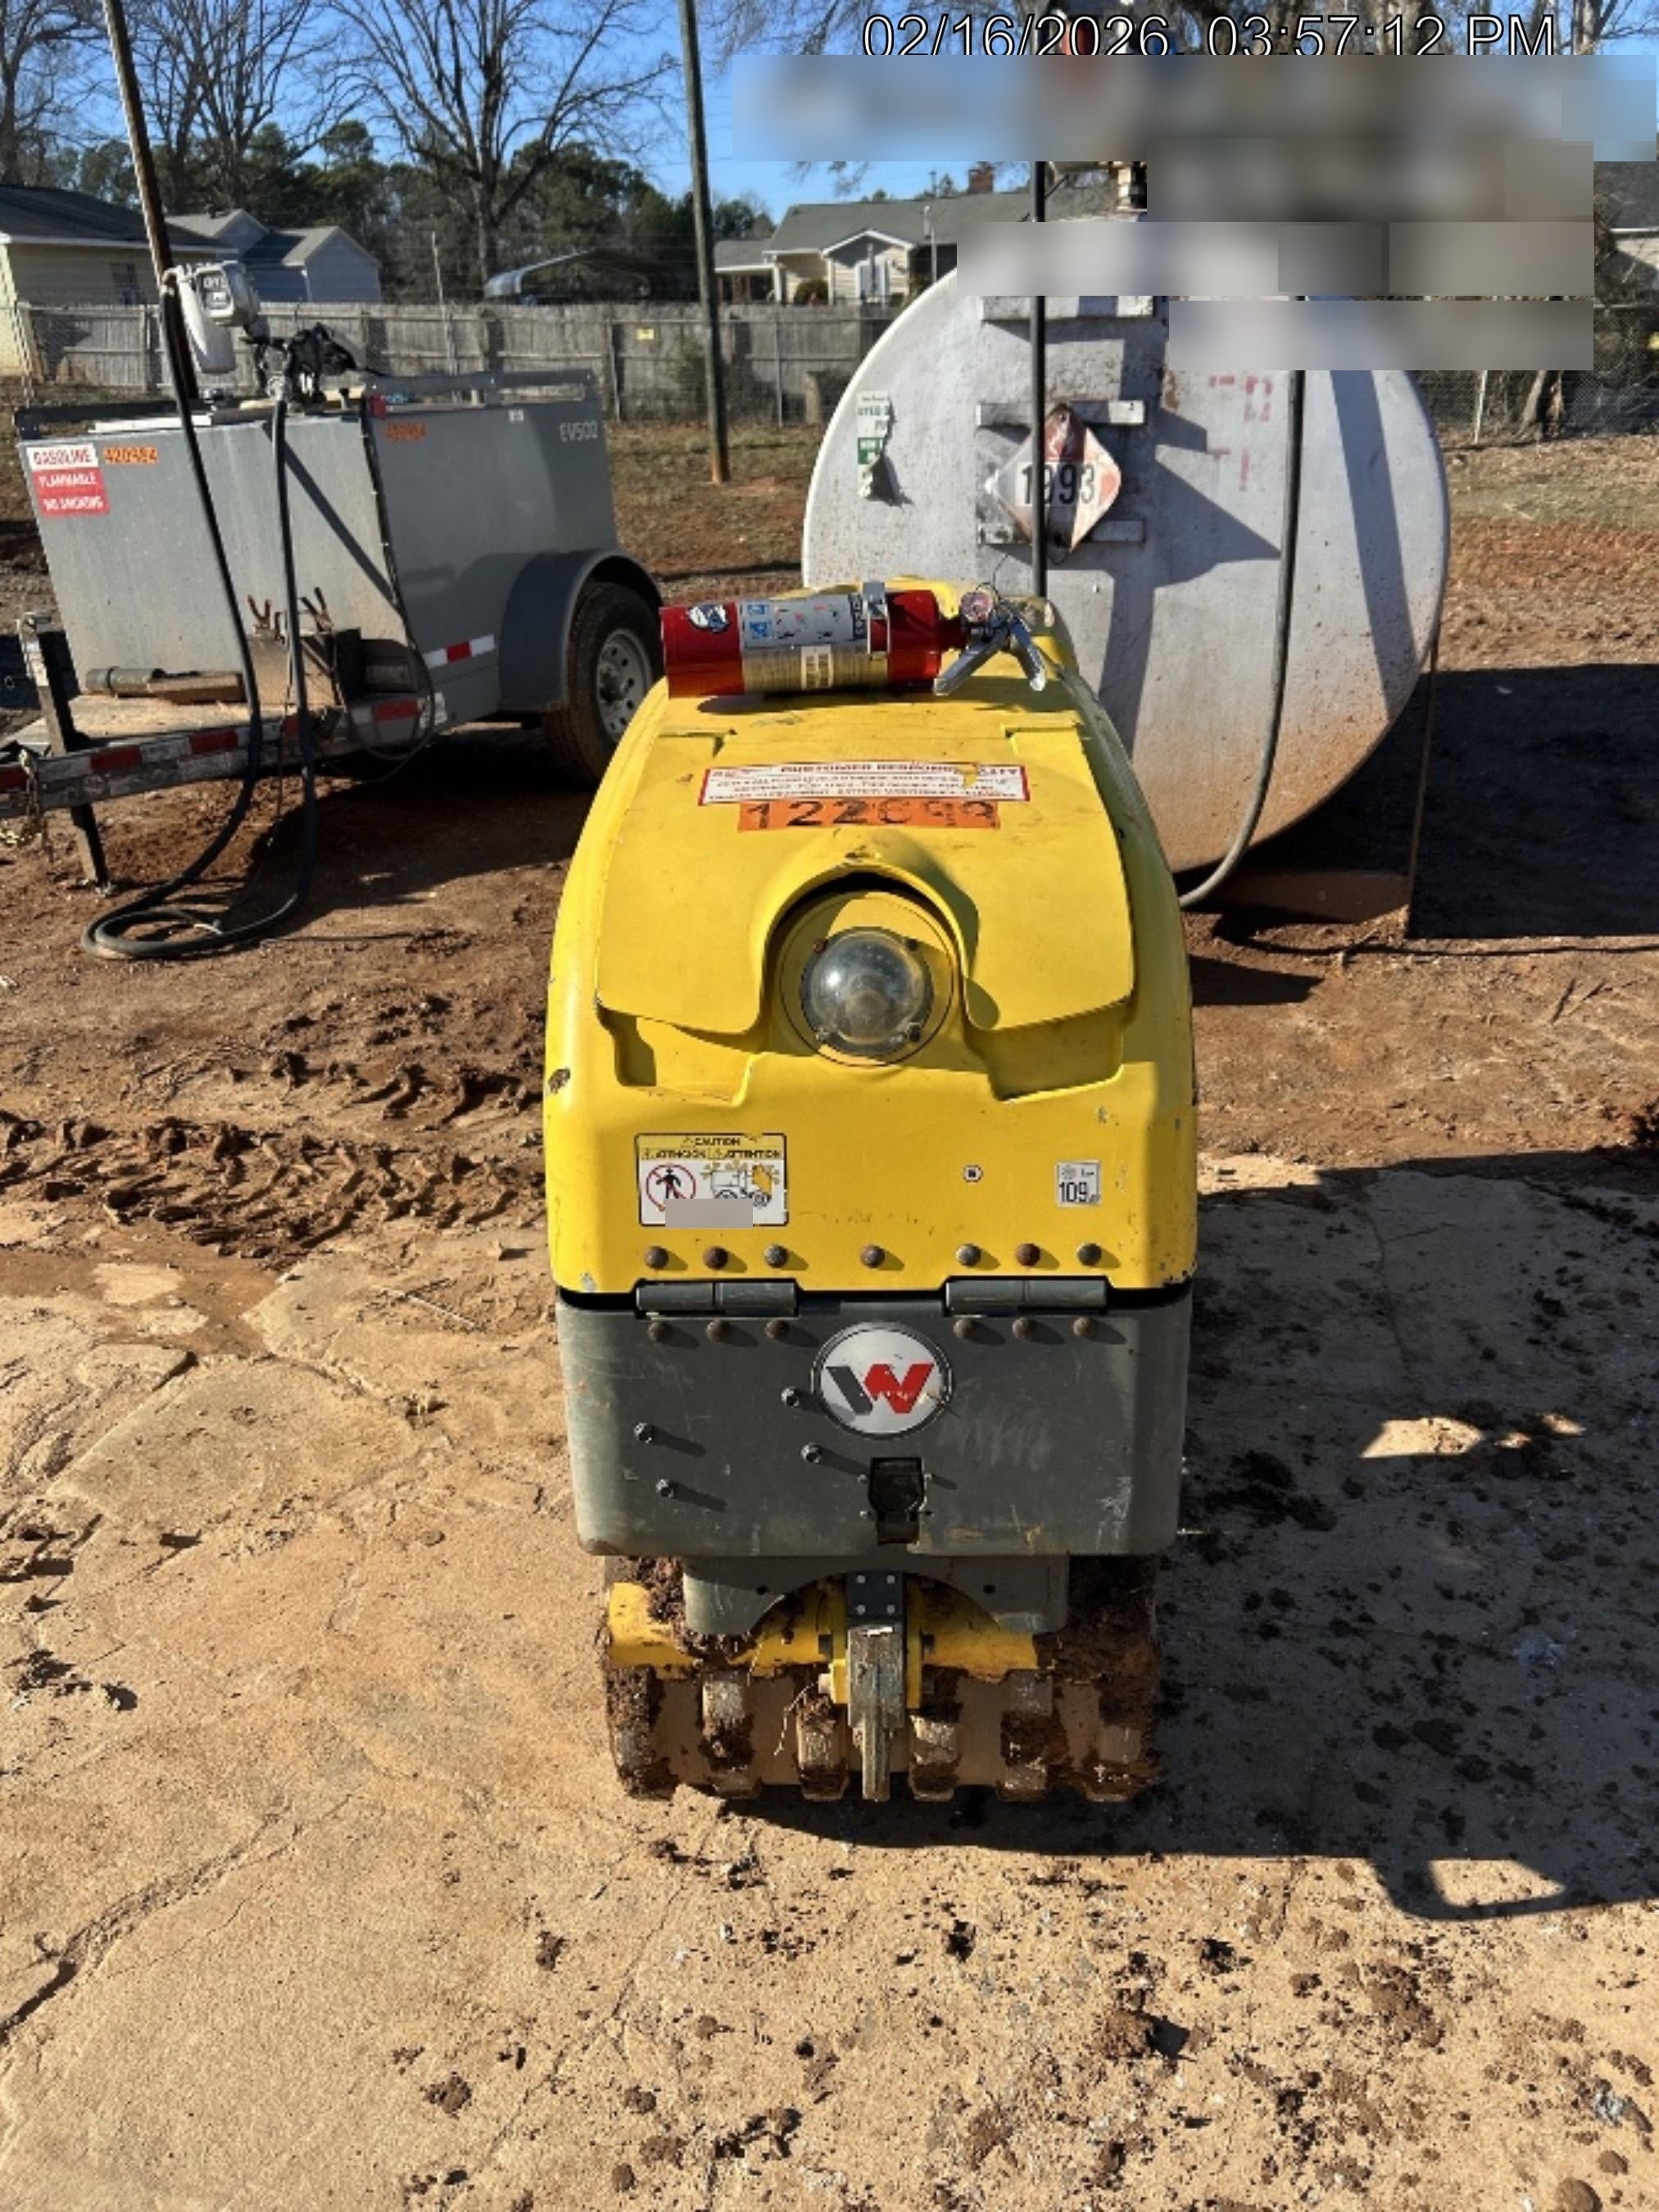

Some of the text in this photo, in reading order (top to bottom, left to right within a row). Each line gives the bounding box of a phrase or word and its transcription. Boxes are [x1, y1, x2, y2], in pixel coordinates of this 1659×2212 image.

[34, 448, 93, 465] GASOLINE
[39, 472, 97, 487] FLAMMABLE
[1022, 464, 1095, 505] 1993
[43, 496, 105, 511] NO SMOKING
[694, 1136, 741, 1147] CAUTION
[1058, 1181, 1088, 1203] 109
